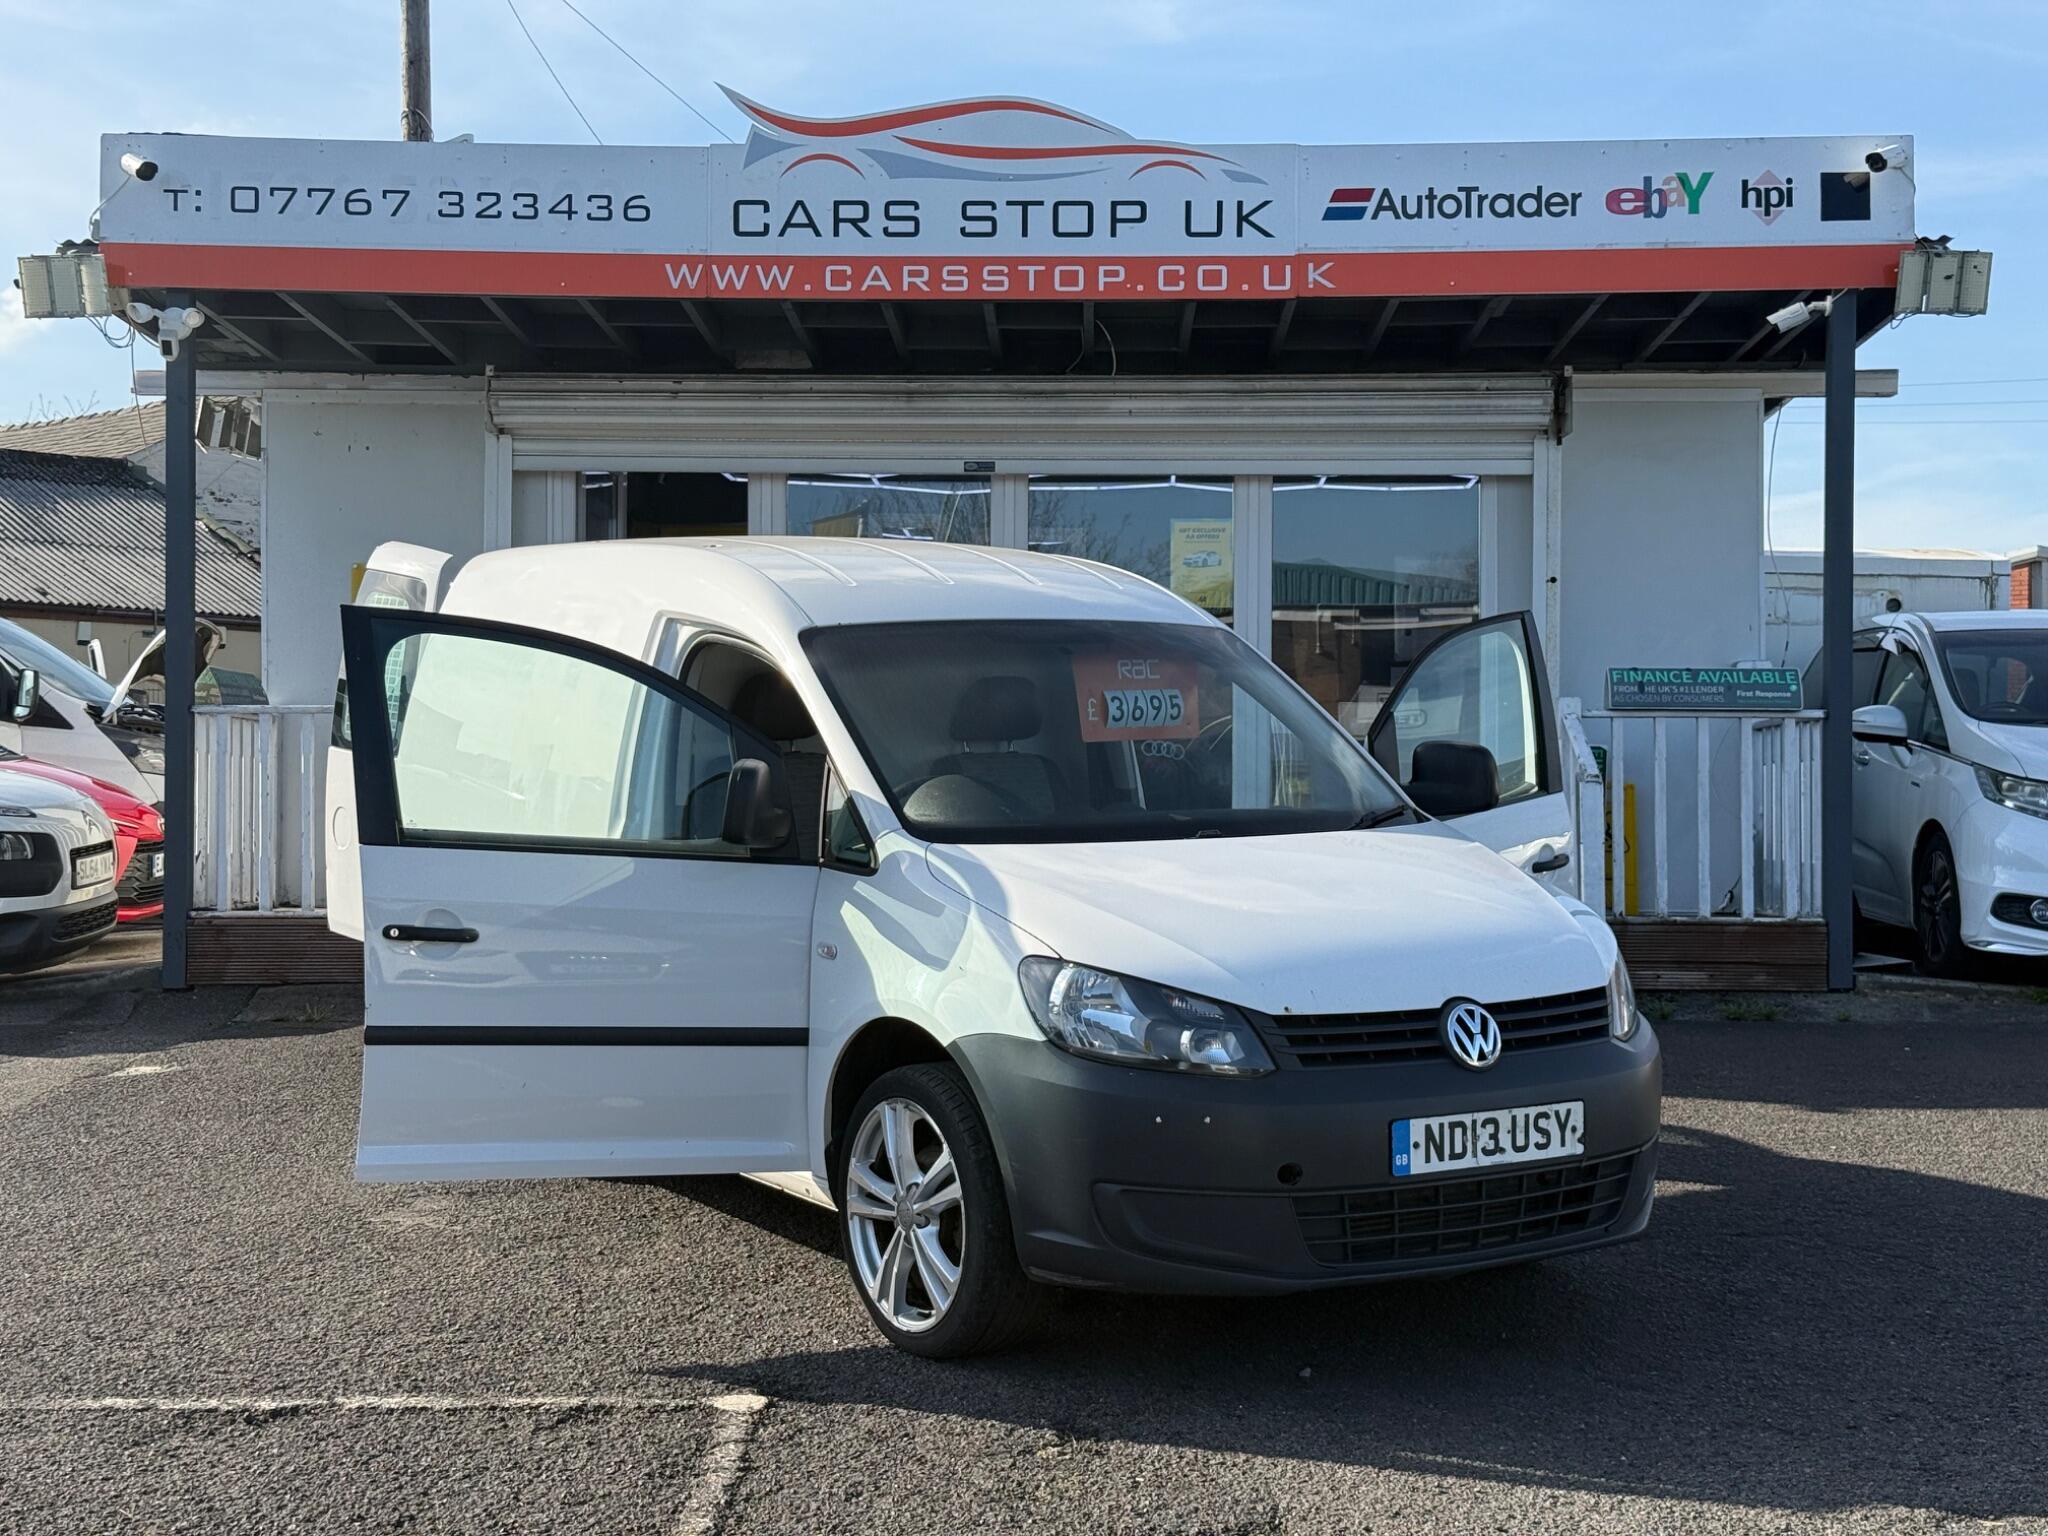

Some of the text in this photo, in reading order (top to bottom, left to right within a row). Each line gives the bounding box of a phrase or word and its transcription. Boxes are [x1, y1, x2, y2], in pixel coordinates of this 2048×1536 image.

[163, 186, 652, 223] T: 07767 323436
[1373, 186, 1582, 219] AutoTrader
[1741, 177, 1794, 217] hpi
[733, 199, 1275, 238] CARS STOP UK
[665, 261, 1337, 293] WWW.CARSSTOP.CO.UK
[1612, 671, 1798, 684] FINANCE AVAILABLE
[1613, 685, 1638, 693] FROM
[1087, 695, 1182, 723] £ 3695
[1396, 1154, 1408, 1165] GB
